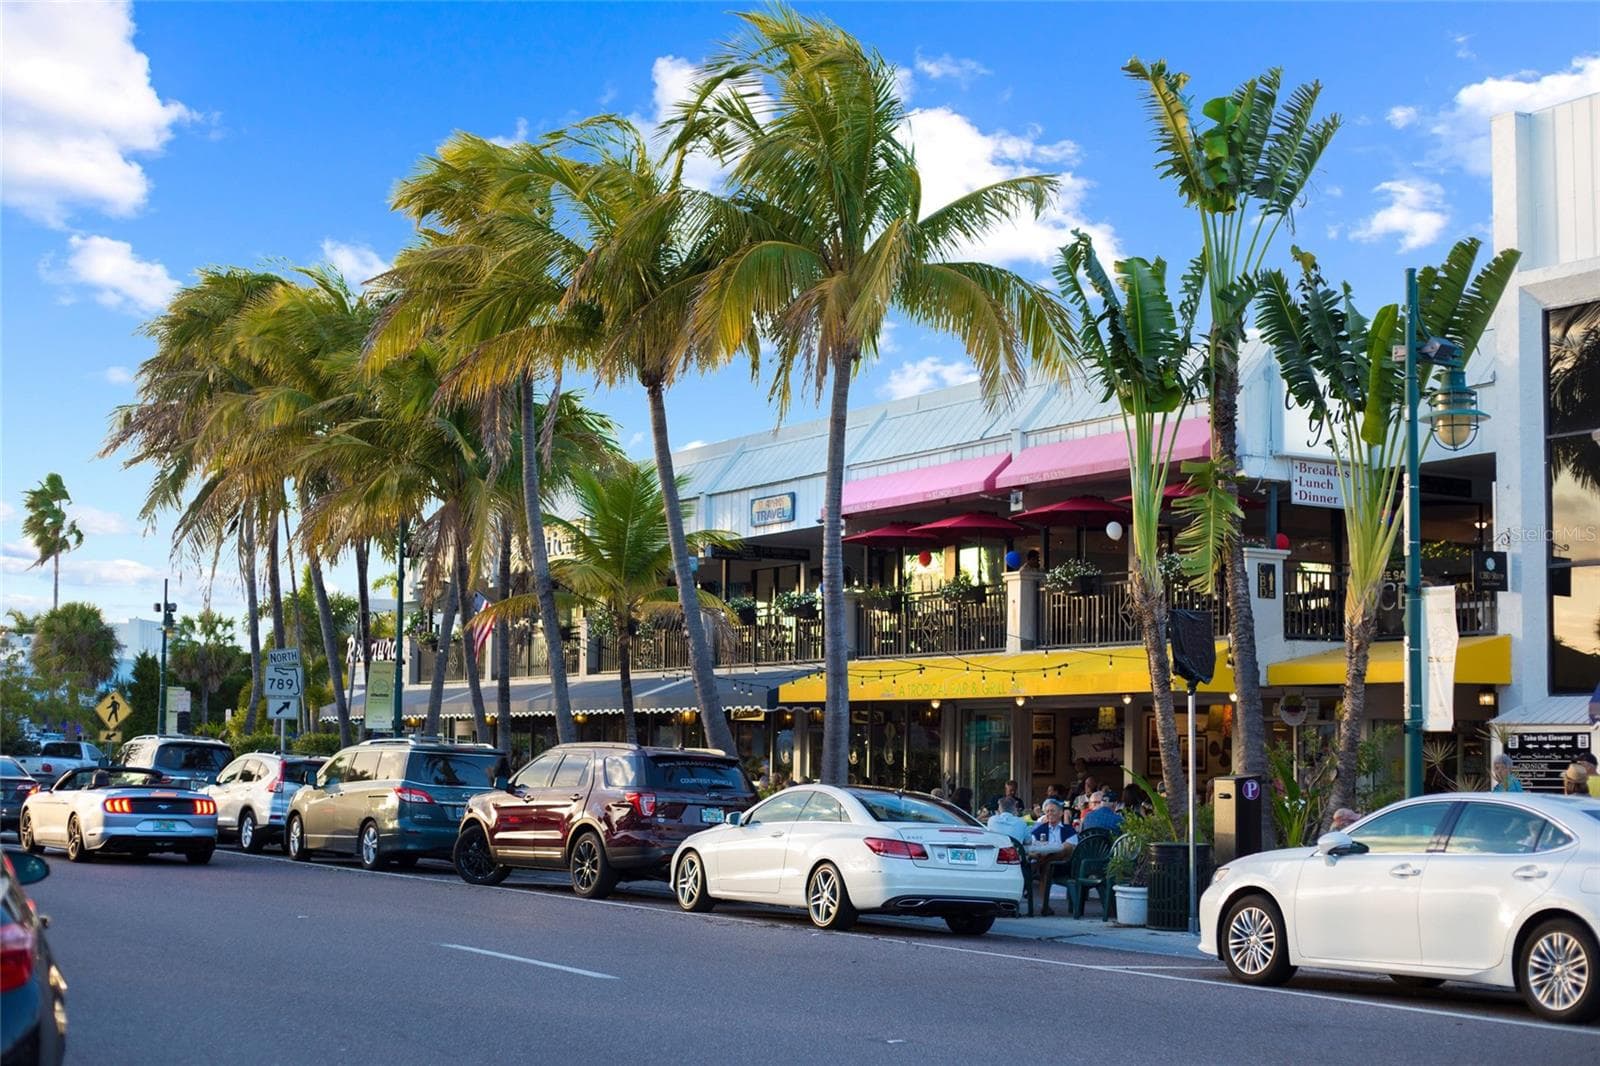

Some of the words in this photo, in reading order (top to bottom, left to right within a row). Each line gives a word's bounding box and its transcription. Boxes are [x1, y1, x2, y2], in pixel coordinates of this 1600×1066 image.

[1299, 477, 1334, 490] Lunch
[1299, 490, 1338, 504] Dinner
[756, 507, 787, 522] TRAVEL
[270, 651, 297, 663] NORTH
[268, 678, 294, 690] 789
[1538, 734, 1548, 742] the
[1247, 782, 1258, 798] P
